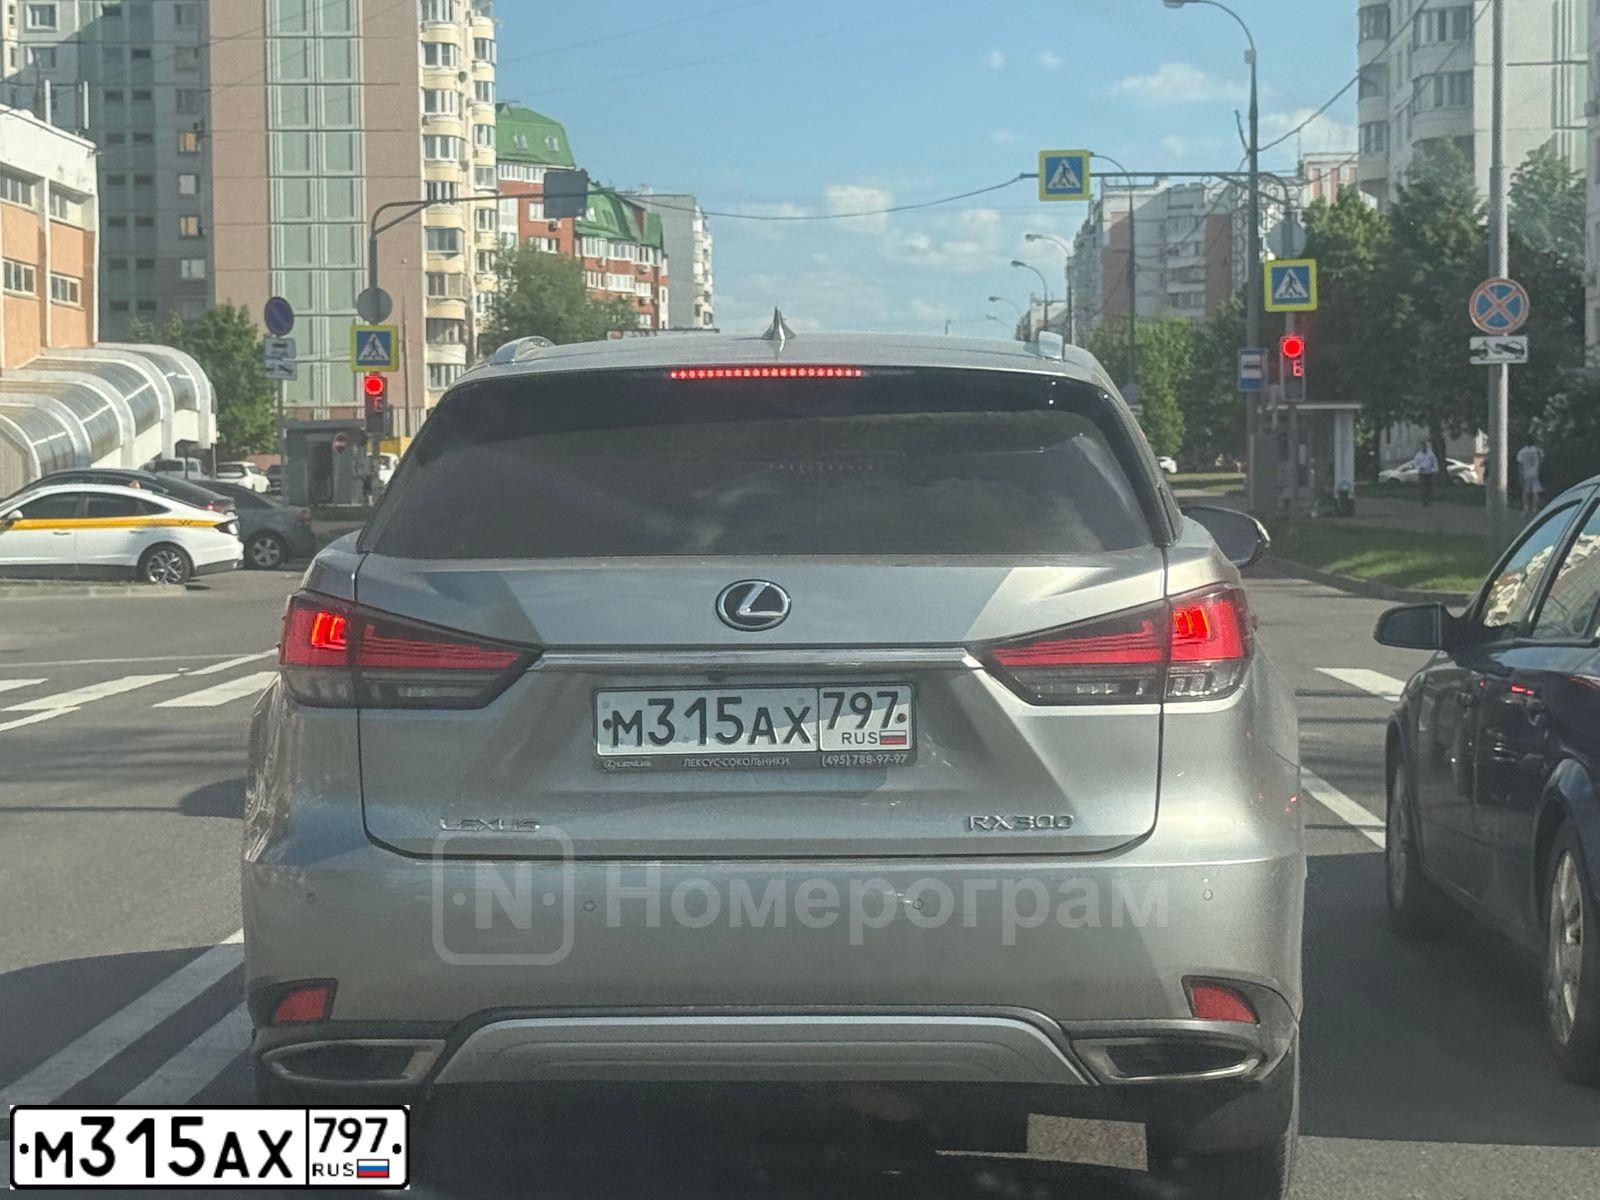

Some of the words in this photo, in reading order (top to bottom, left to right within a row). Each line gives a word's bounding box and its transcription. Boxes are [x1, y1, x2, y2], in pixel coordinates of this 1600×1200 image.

[823, 691, 899, 729] 797
[842, 731, 878, 744] RUS
[822, 755, 850, 767] (495)
[852, 754, 908, 765] 788-97-97
